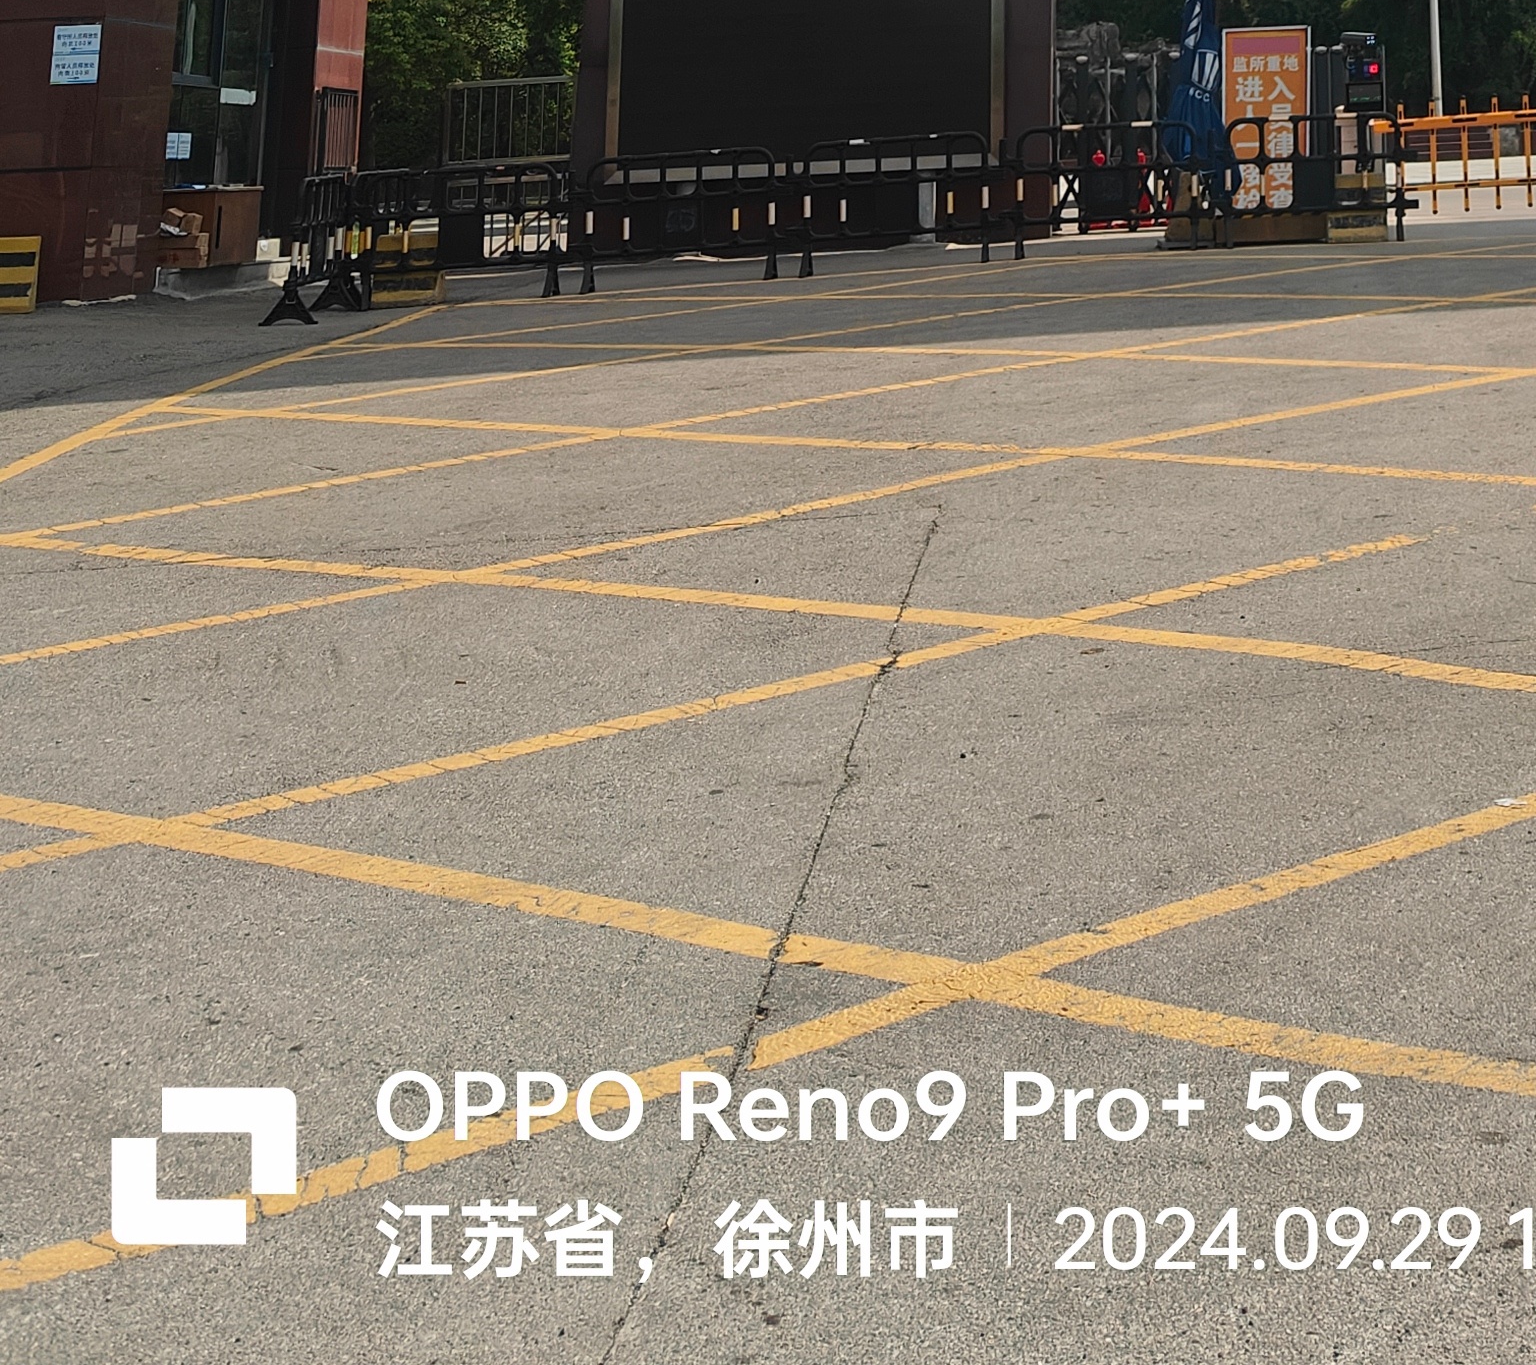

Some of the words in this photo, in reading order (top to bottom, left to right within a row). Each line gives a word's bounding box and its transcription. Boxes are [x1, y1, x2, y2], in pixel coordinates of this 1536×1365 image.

[1232, 55, 1300, 73] 监所重地
[1235, 75, 1296, 102] 进入
